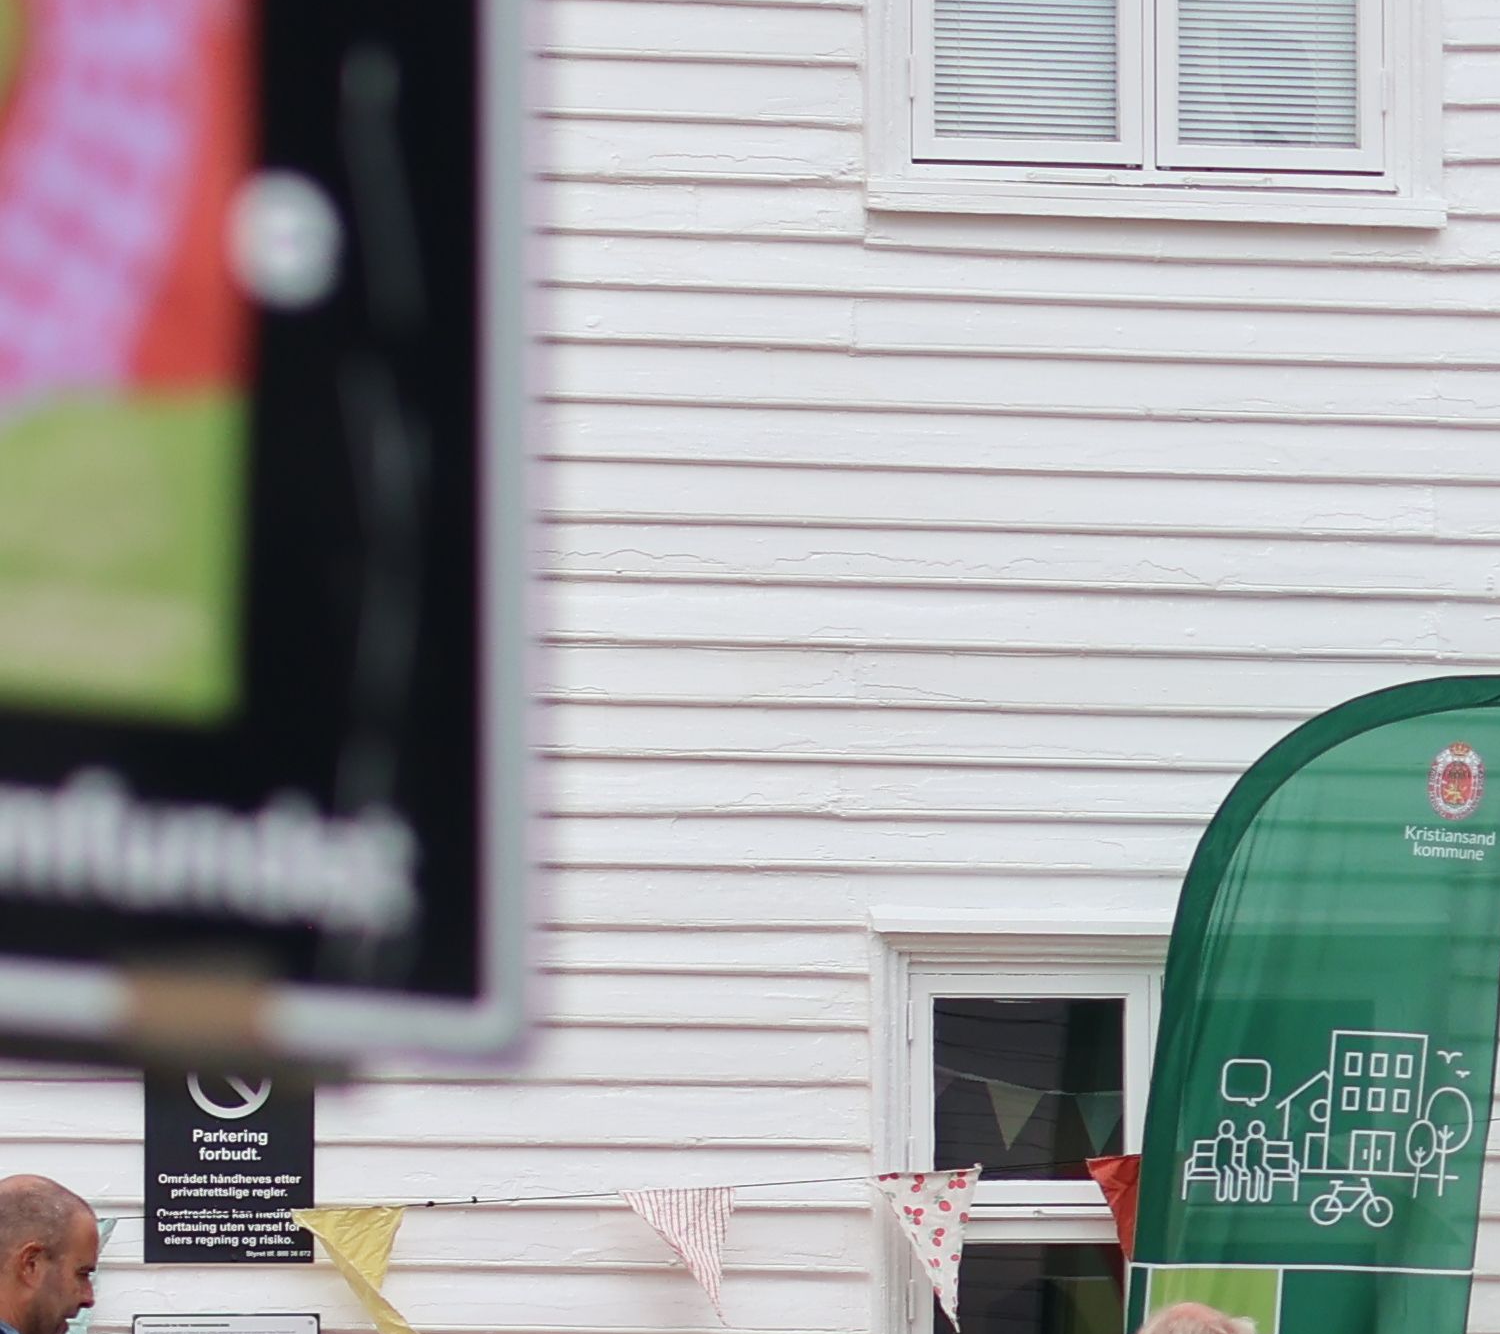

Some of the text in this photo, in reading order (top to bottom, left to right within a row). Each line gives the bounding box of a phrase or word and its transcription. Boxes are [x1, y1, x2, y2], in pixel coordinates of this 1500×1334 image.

[1404, 825, 1496, 846] Kristiansand
[1413, 842, 1485, 861] kommune
[192, 1129, 269, 1146] Parkering
[199, 1147, 262, 1161] forbudt.
[158, 1173, 302, 1184] Området håndheves etter
[170, 1187, 289, 1199] privatrettslige regler.
[156, 1208, 230, 1219] Overtredelse
[158, 1222, 217, 1234] borttauing
[219, 1223, 245, 1232] uten
[247, 1222, 282, 1232] varsel
[164, 1234, 295, 1247] eiers regning og risiko.
